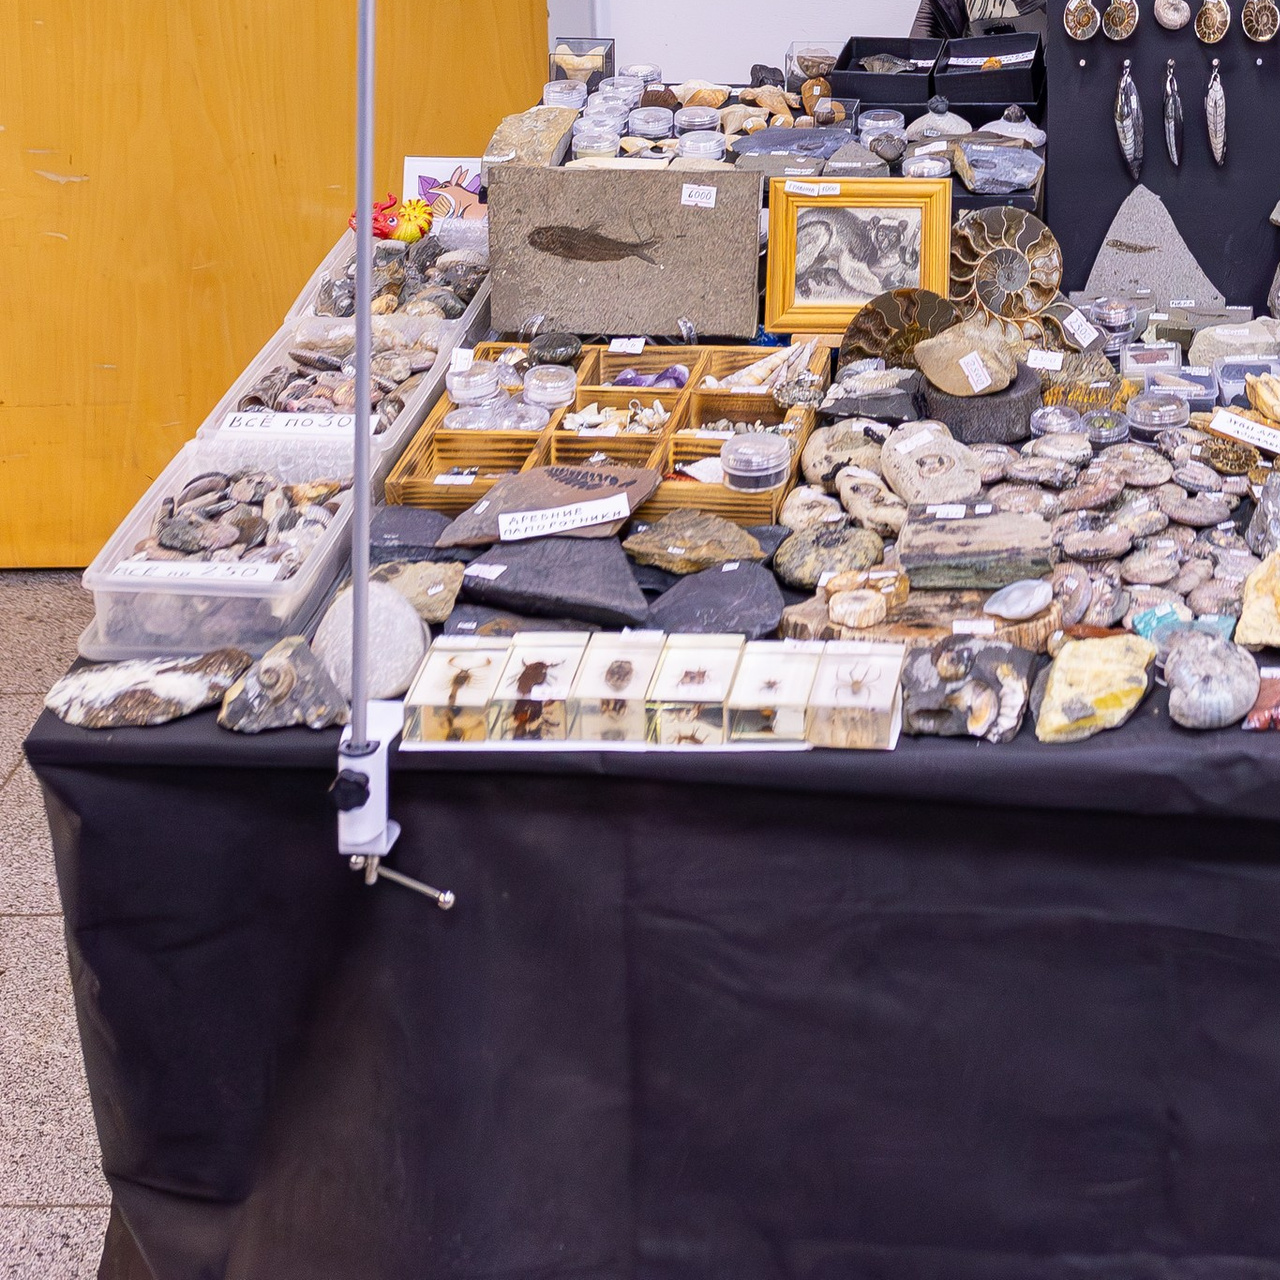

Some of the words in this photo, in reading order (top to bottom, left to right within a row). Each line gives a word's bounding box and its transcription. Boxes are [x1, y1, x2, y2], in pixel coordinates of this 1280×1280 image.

[687, 189, 712, 201] 6000
[228, 413, 276, 429] ВСЁ
[503, 510, 622, 536] ПАПОРОТНИКИ
